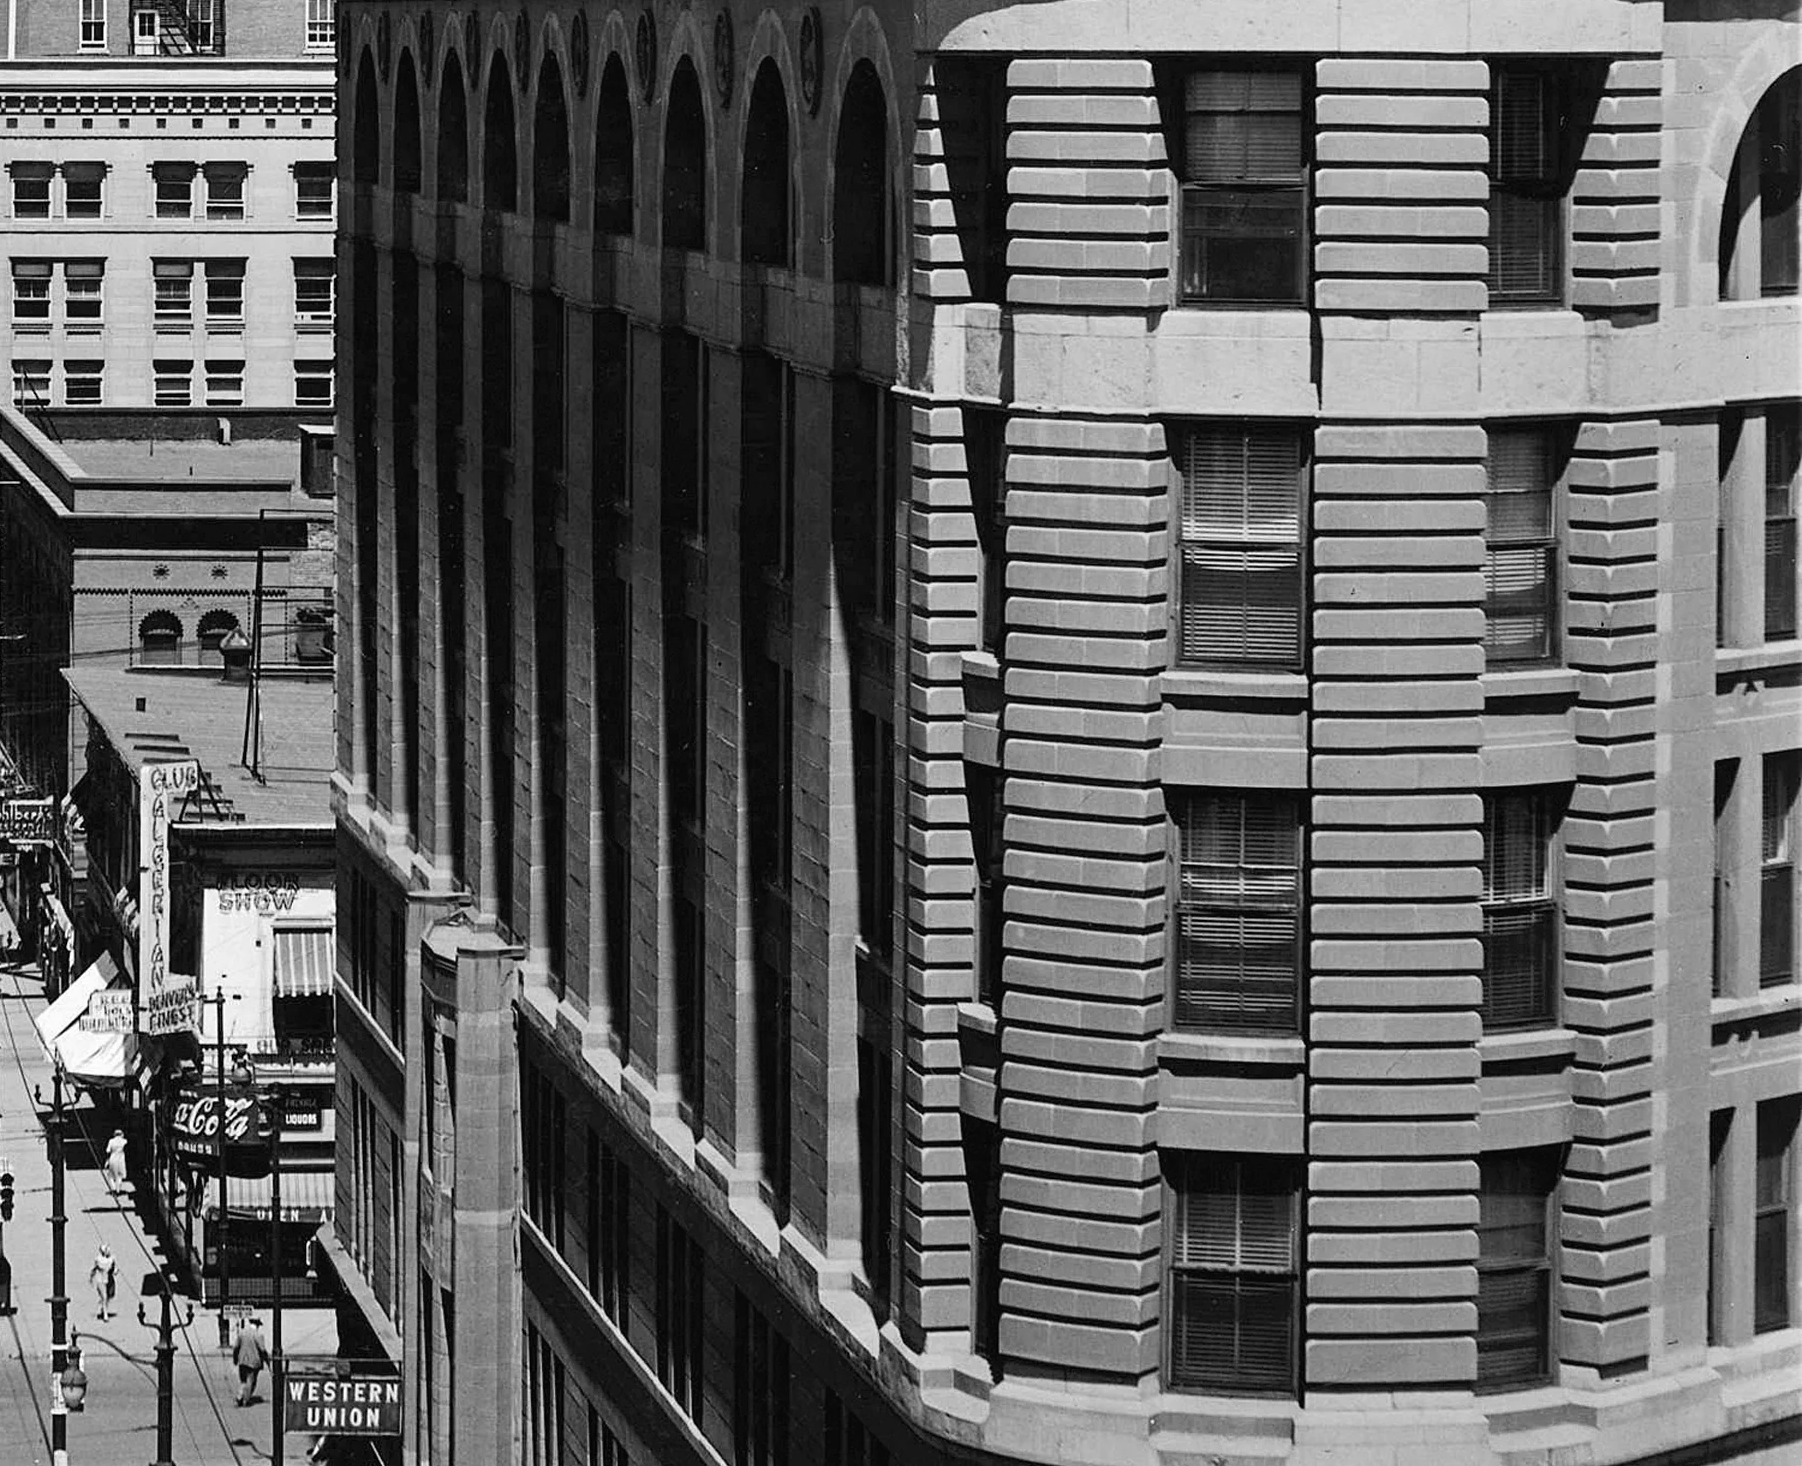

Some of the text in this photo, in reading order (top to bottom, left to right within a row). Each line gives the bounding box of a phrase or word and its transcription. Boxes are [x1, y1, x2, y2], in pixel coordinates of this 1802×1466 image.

[218, 891, 297, 912] SHOW
[289, 1381, 398, 1404] WESTERN
[307, 1406, 380, 1428] UNION
